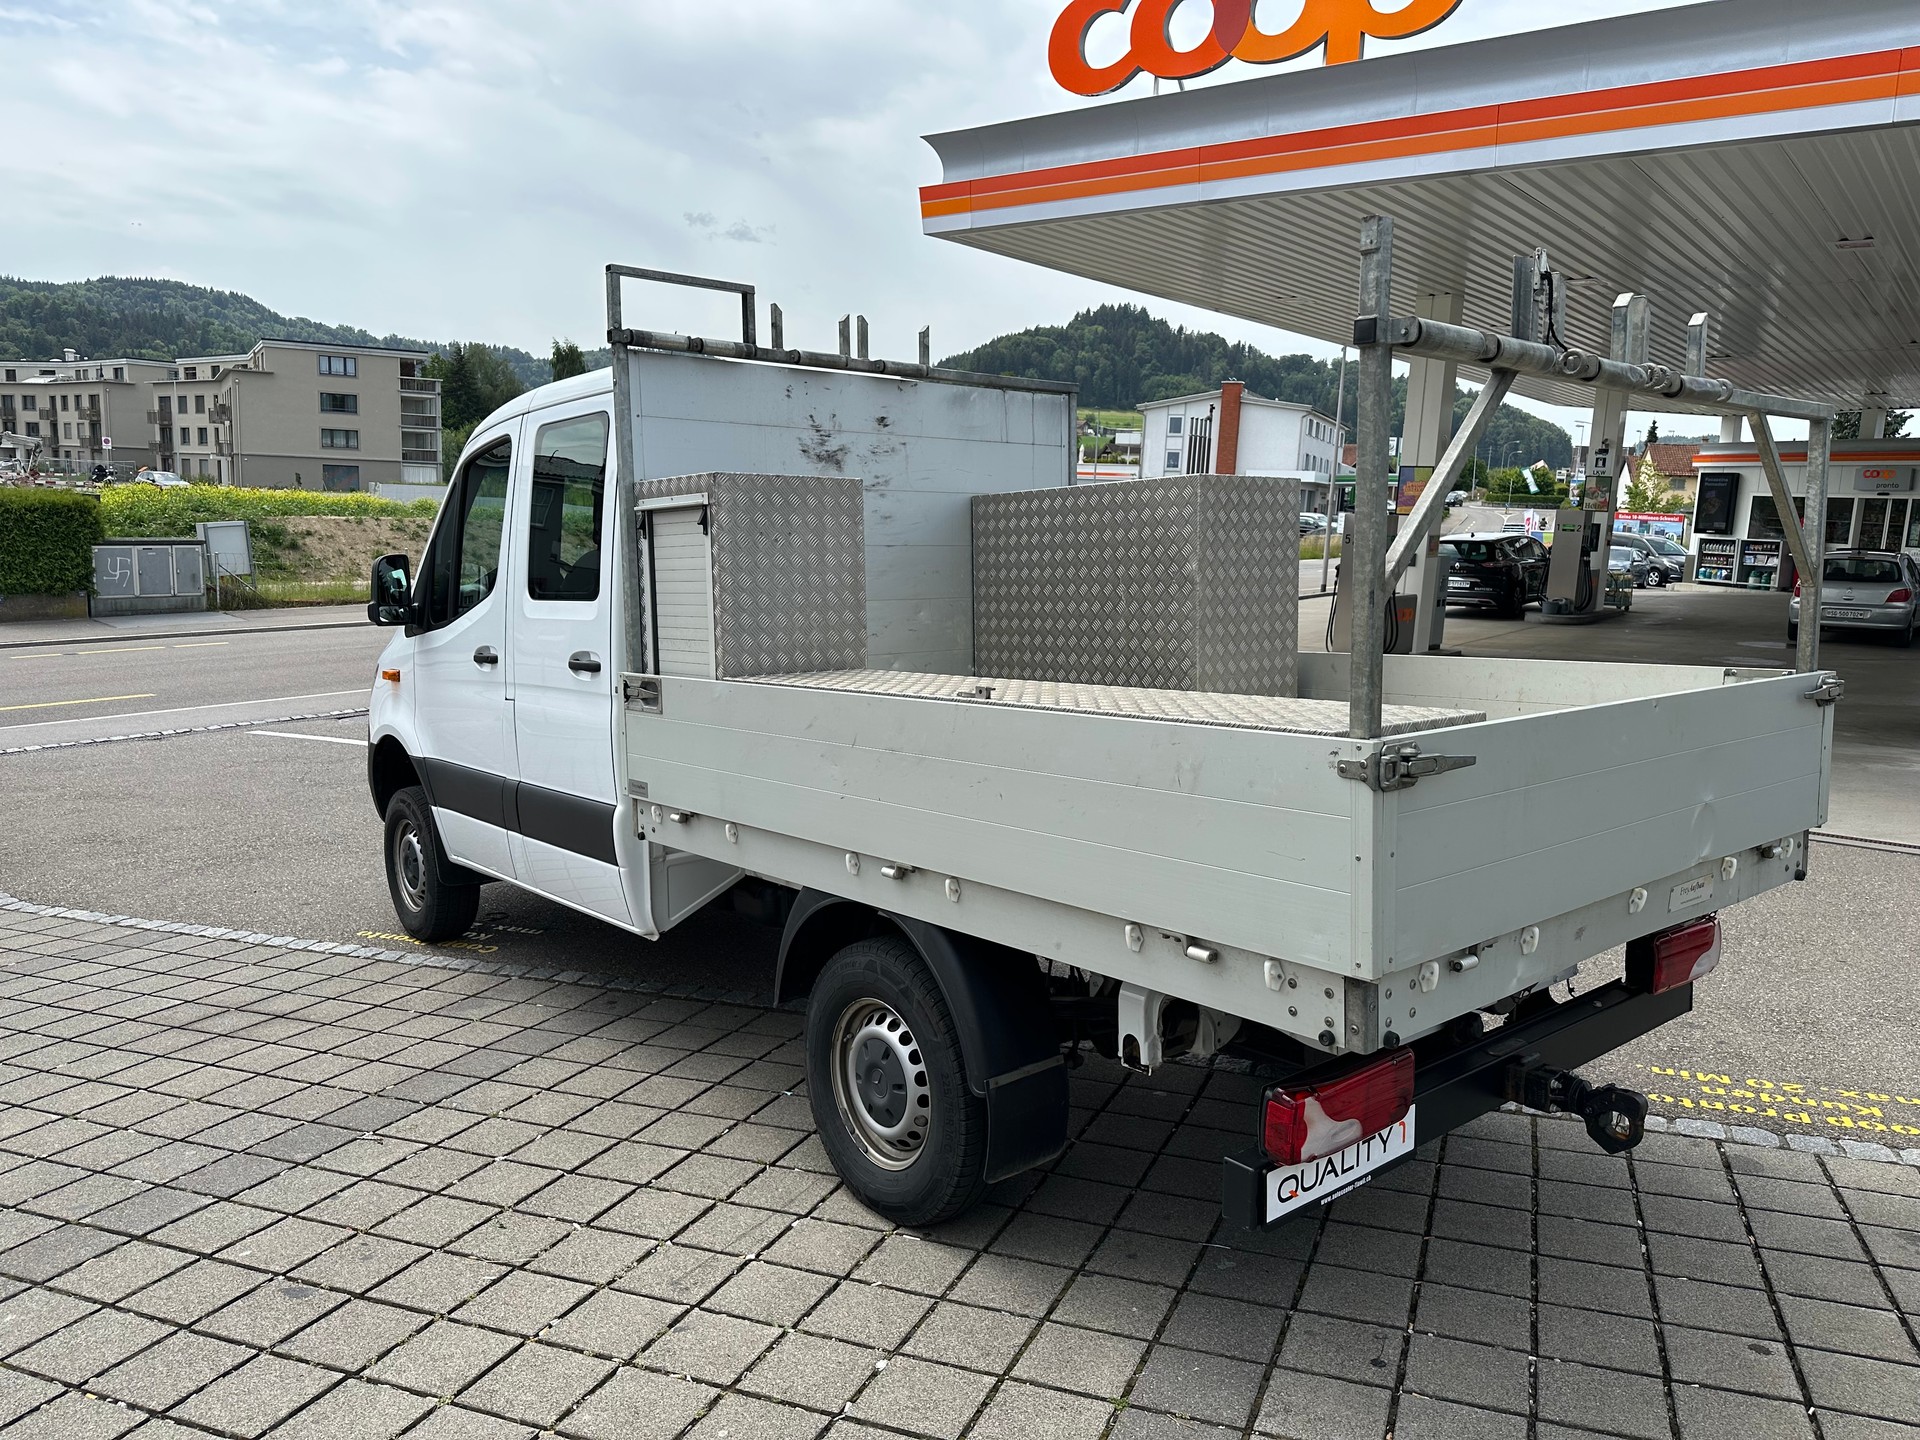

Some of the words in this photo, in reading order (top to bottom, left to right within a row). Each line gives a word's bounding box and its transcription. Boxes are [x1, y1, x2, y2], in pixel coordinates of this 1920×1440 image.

[1344, 534, 1351, 544] 5
[1745, 1078, 1806, 1092] 20
[1647, 1093, 1812, 1124] pronto
[1700, 1085, 1884, 1118] Kunden
[1826, 1116, 1920, 1135] oop
